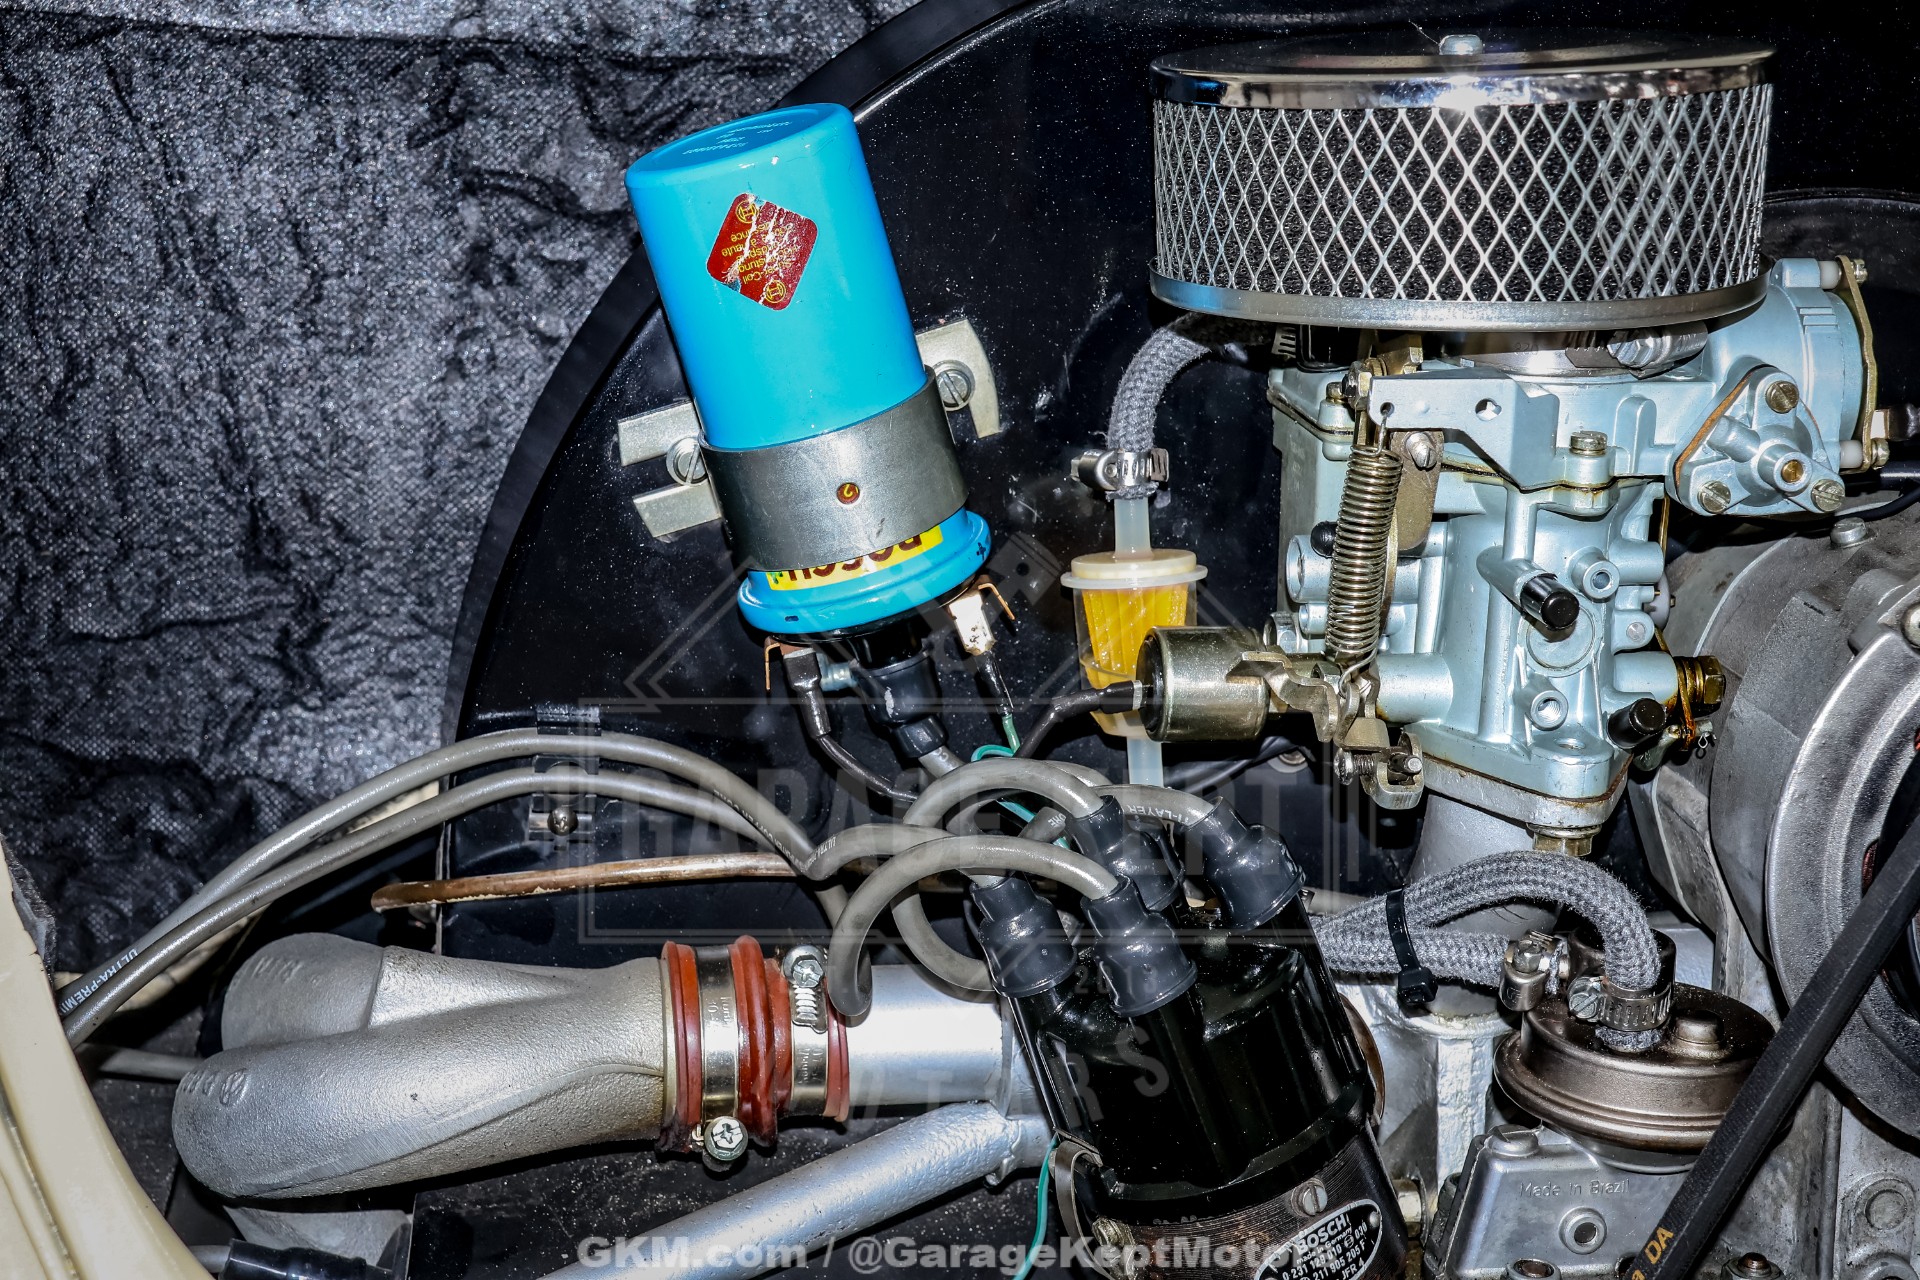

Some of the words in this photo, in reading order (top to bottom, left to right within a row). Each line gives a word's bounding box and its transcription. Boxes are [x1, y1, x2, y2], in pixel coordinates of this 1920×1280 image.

[60, 948, 139, 1013] ULTRA-PREMI
[1520, 1181, 1561, 1197] Made
[1590, 1179, 1630, 1194] Brazil
[1296, 1214, 1347, 1255] BOSCH
[1297, 1248, 1316, 1265] made
[1316, 1245, 1324, 1254] in
[1325, 1227, 1353, 1248] Germany
[1645, 1227, 1674, 1264] DA
[1291, 1264, 1309, 1279] 231
[1309, 1255, 1326, 1273] 129
[1327, 1244, 1342, 1261] 010
[1312, 1265, 1328, 1280] 211
[1330, 1256, 1346, 1274] 905
[1346, 1246, 1361, 1263] 205
[1360, 1238, 1366, 1252] F
[1341, 1263, 1358, 1280] JFR
